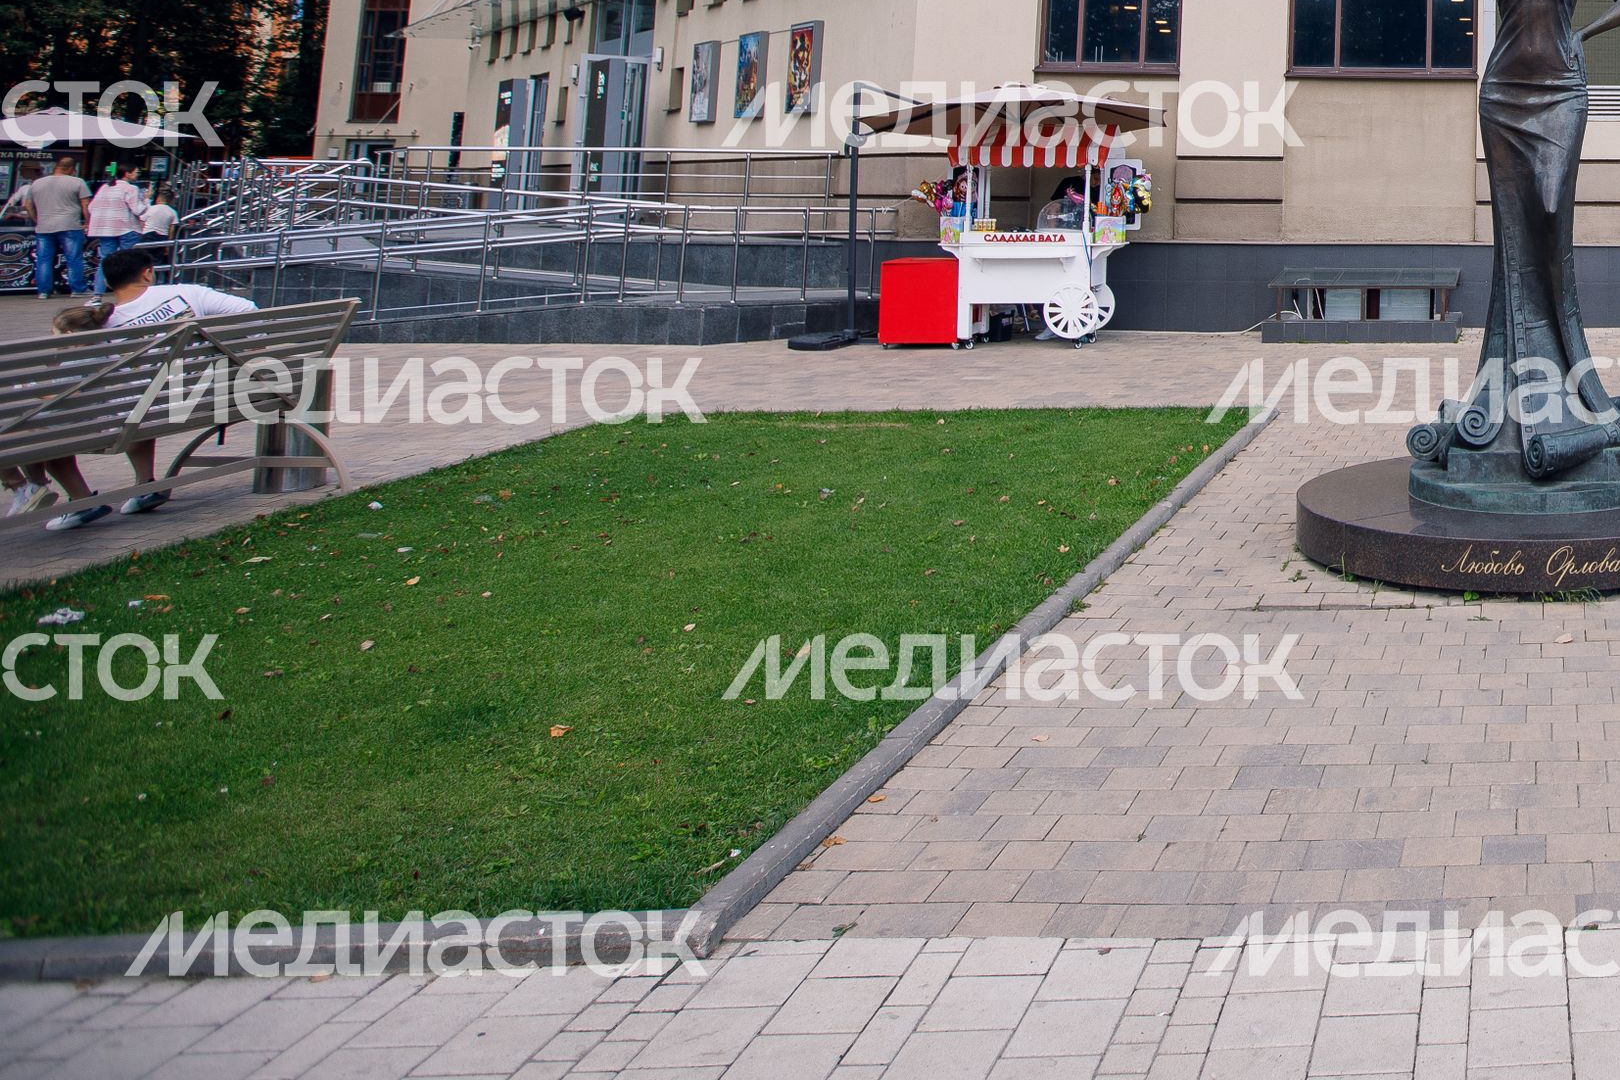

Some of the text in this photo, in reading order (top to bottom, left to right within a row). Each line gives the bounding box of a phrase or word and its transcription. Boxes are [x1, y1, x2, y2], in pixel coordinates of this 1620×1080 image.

[983, 234, 1066, 243] СЛАДКАЯ ВАТА
[1441, 544, 1525, 576] Любовь
